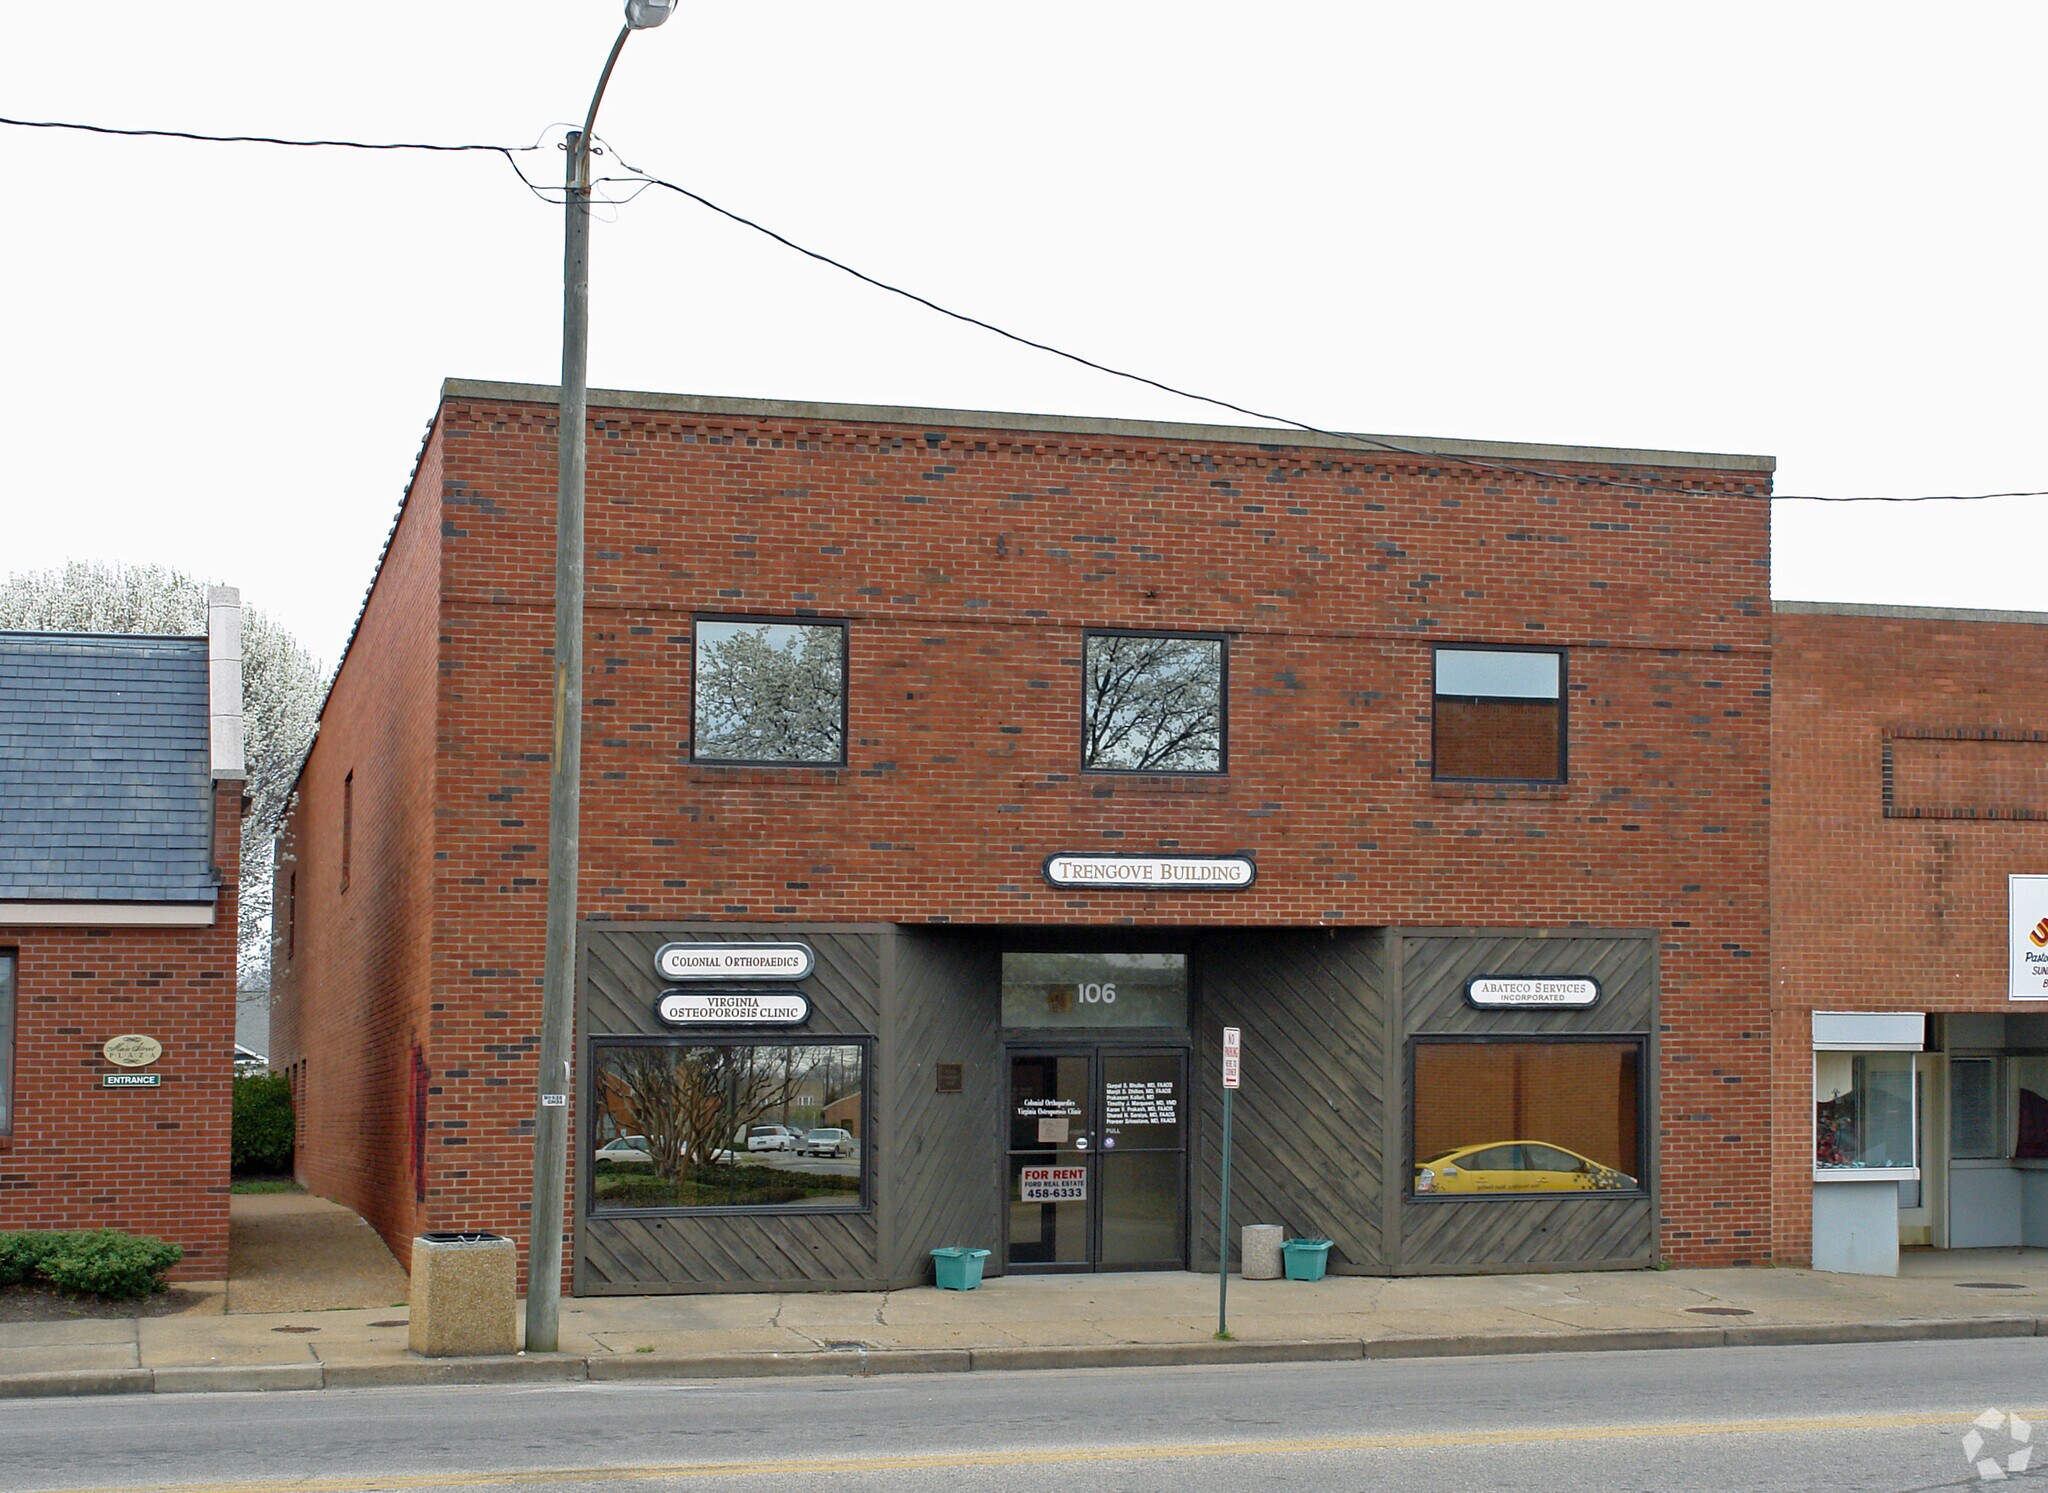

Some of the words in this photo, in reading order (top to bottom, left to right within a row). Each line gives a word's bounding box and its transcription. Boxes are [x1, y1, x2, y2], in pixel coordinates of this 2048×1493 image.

[1059, 862, 1152, 879] TRENGOVE
[1161, 864, 1241, 880] BUILDING
[672, 956, 720, 967] COLONIAL
[725, 956, 798, 967] ORTHOPAEDICS
[1482, 983, 1530, 992] ABATECO
[1535, 983, 1586, 992] SERVICES
[1078, 983, 1116, 1003] 106
[708, 998, 759, 1007] VIRGINIA
[670, 1008, 757, 1017] OSTEOPOROSIS
[760, 1008, 798, 1017] CLINIC
[132, 1042, 156, 1052] Street
[1018, 1108, 1036, 1116] Virginia
[1025, 1171, 1048, 1179] FOR
[1054, 1170, 1084, 1179] RENT
[1028, 1189, 1081, 1198] 458-6333
